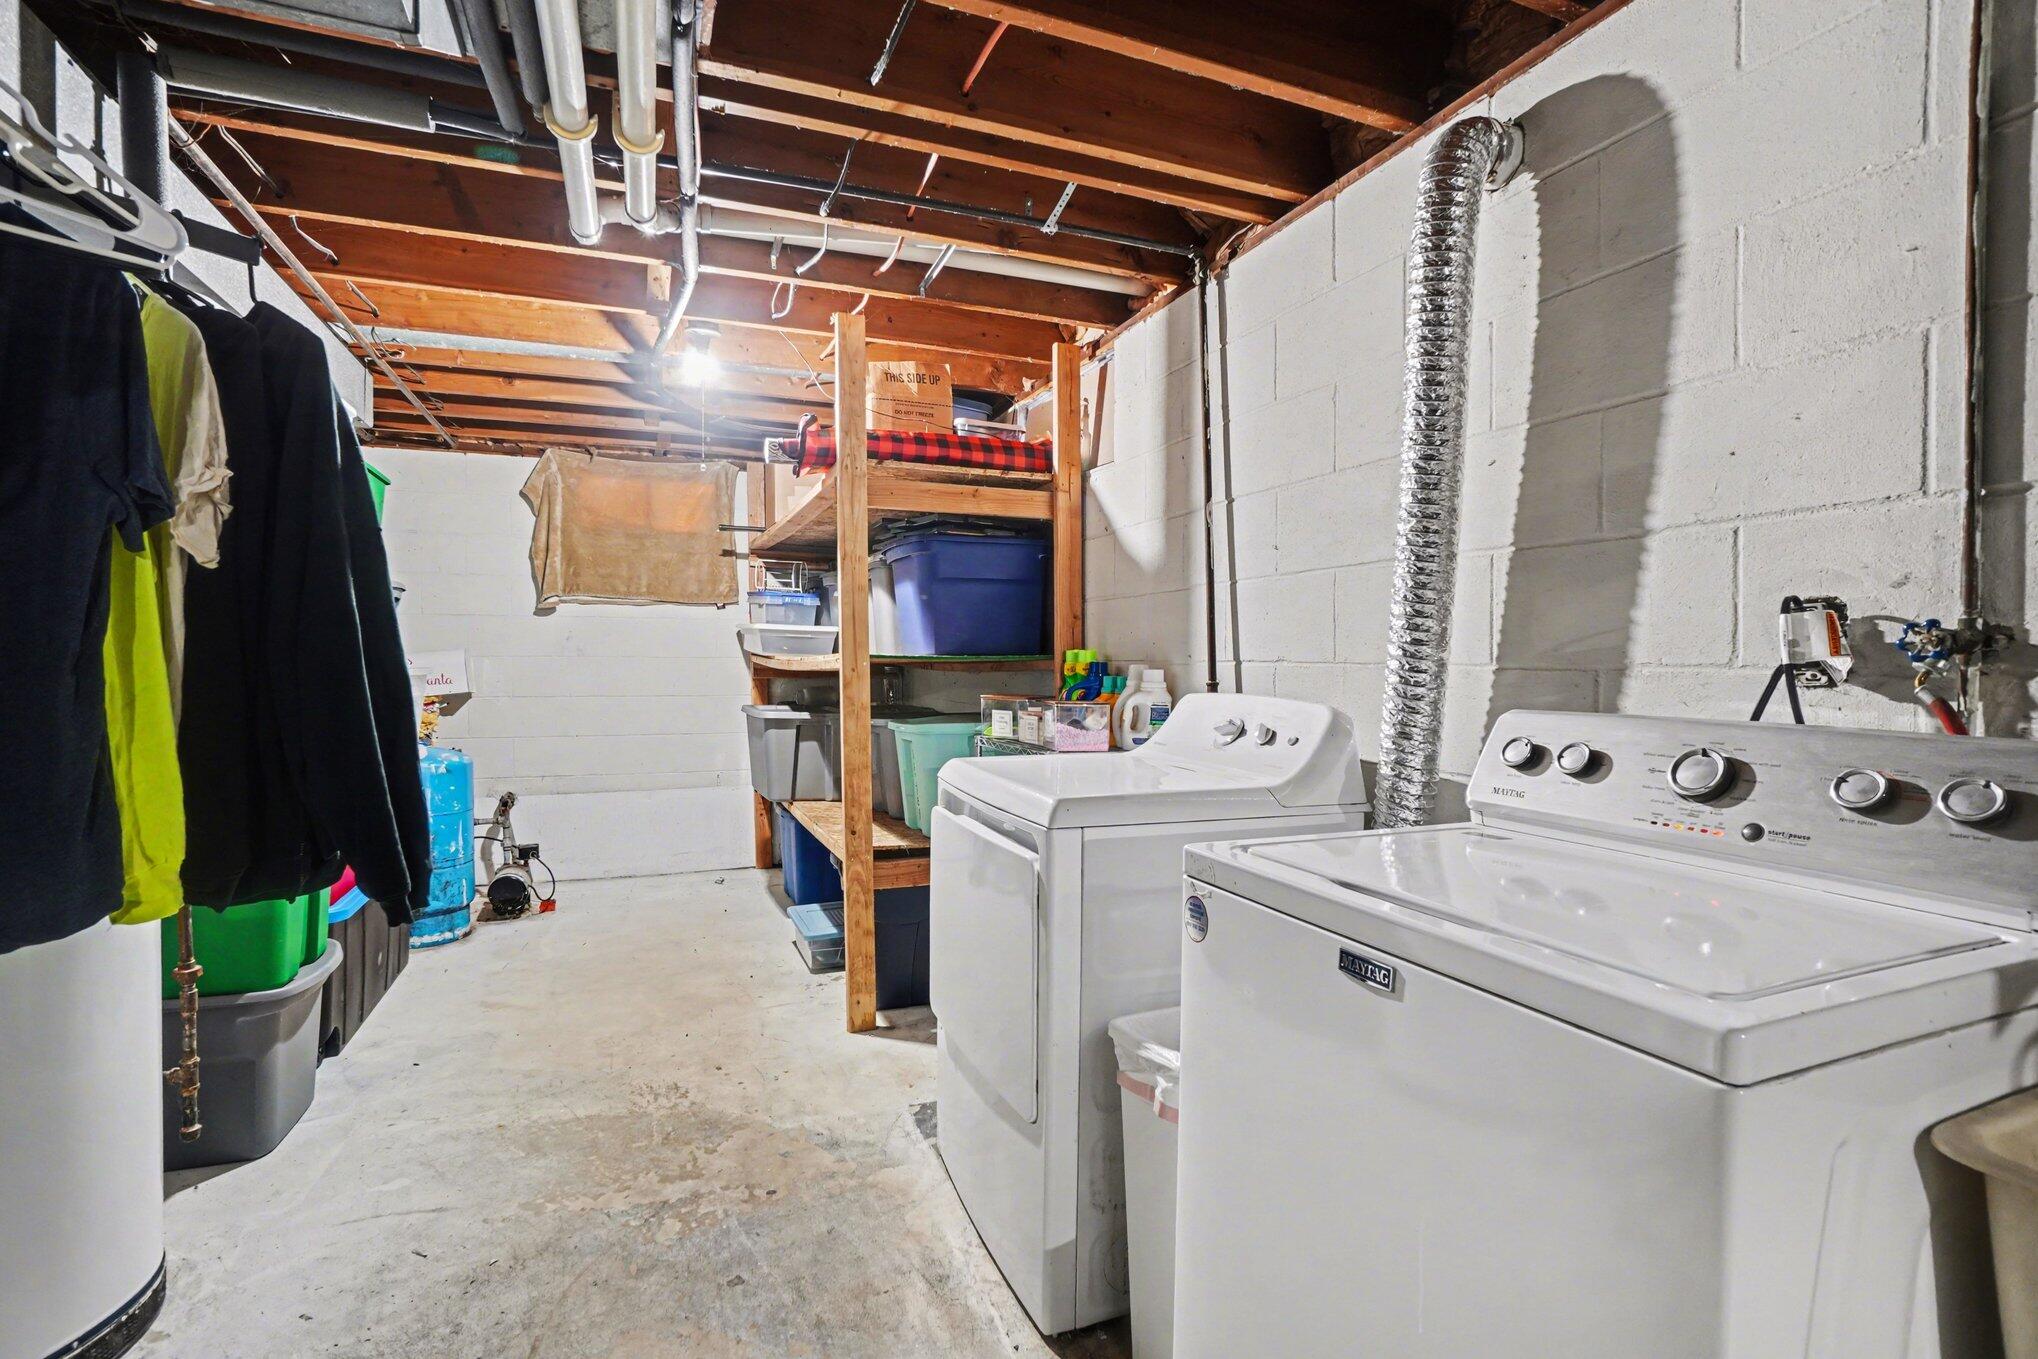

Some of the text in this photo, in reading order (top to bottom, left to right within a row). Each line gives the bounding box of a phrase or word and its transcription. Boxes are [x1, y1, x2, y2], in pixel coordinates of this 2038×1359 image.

[884, 372, 941, 385] THIS SIDE UP
[426, 673, 453, 686] anta
[1491, 787, 1526, 799] MAYTAG
[1340, 953, 1390, 986] MAYTAG
